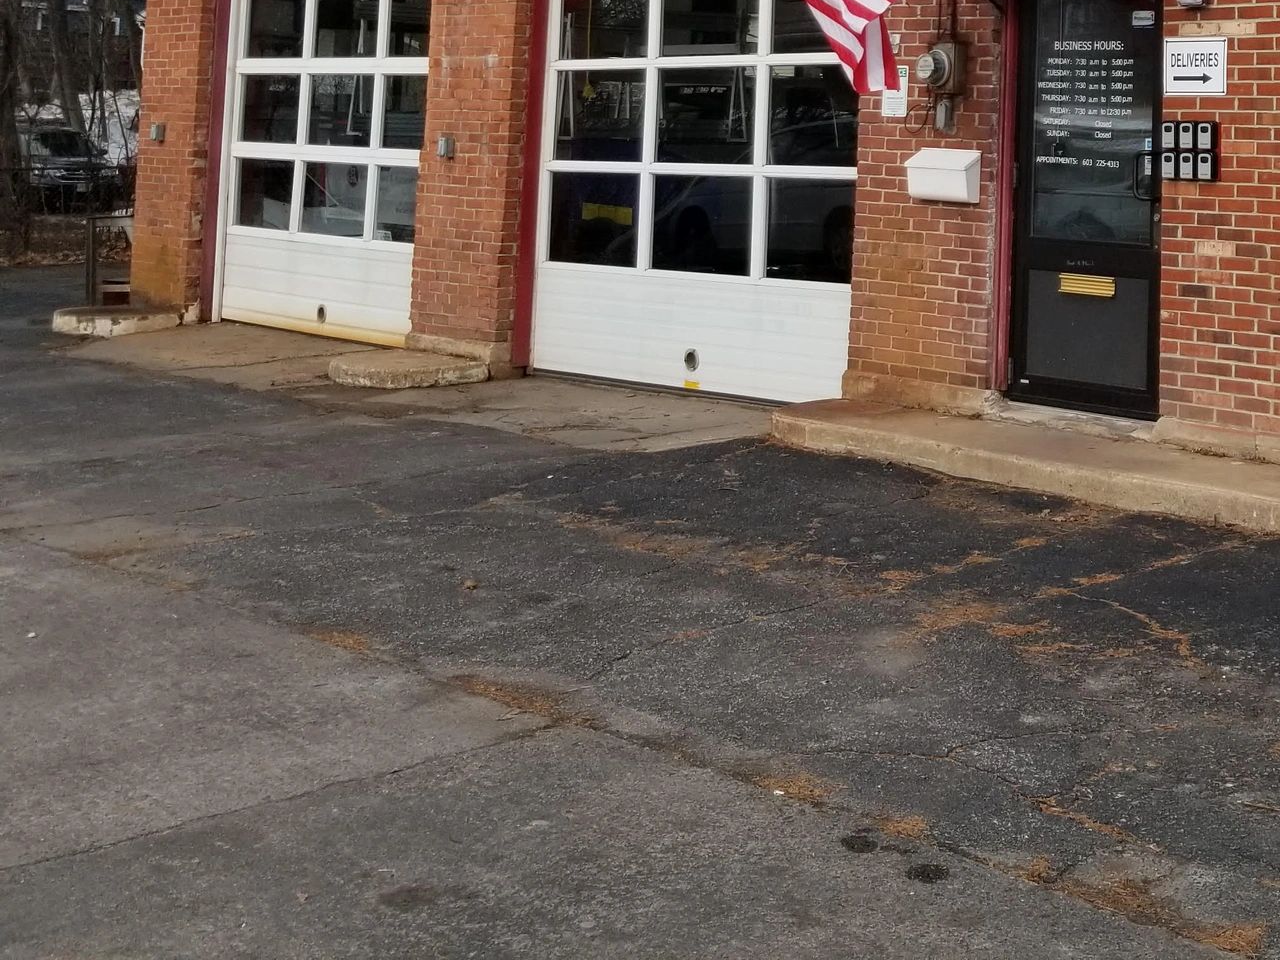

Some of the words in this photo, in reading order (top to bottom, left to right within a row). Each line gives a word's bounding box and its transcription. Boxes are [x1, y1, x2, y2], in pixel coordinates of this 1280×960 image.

[1054, 41, 1092, 51] BUSINESS
[1094, 40, 1124, 51] HOURS:
[1170, 52, 1219, 68] DELIVERIES
[1094, 131, 1112, 139] Closed
[1096, 159, 1120, 168] 225-4313
